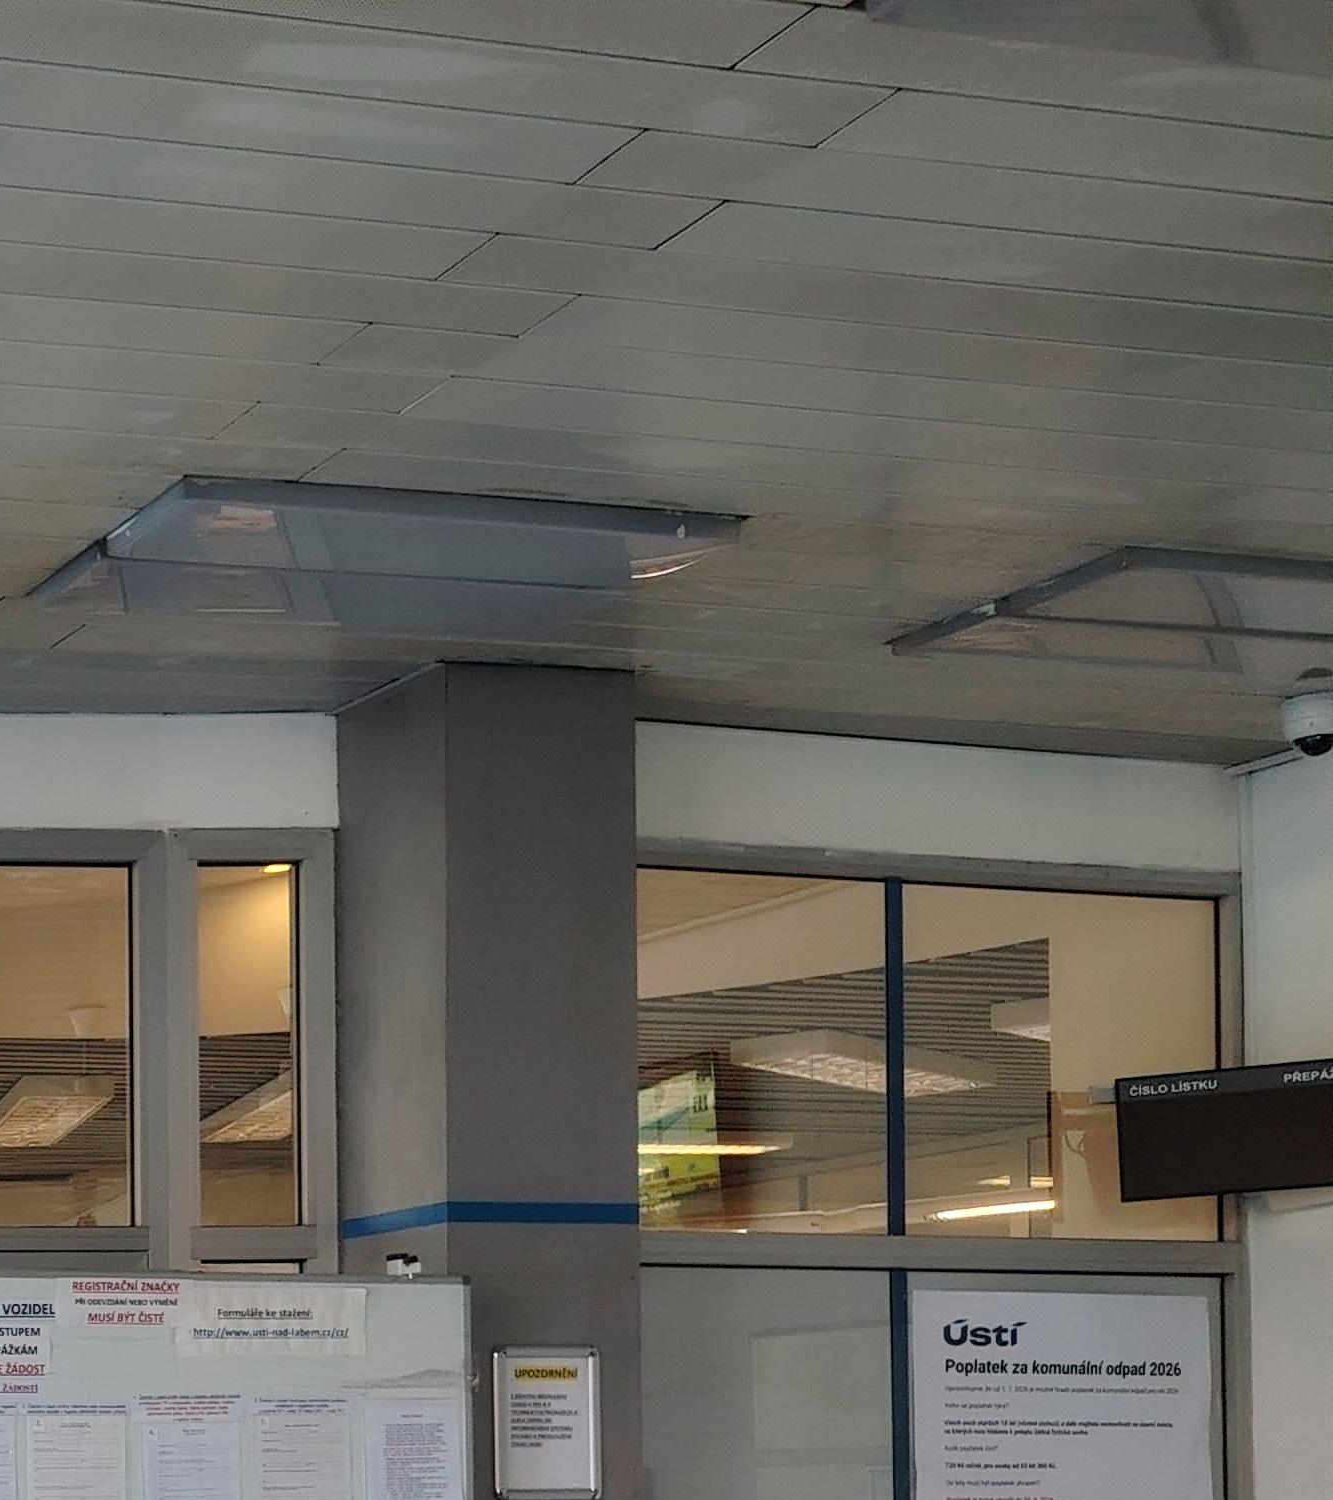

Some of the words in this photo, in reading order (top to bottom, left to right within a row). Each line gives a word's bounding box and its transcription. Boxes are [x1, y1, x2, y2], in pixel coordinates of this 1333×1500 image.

[1129, 1082, 1168, 1097] ČÍSLO
[1171, 1079, 1218, 1093] LÍSTKU
[72, 1280, 138, 1291] REGISTRAČNÍ
[141, 1280, 180, 1292] ZNAČKY
[2, 1303, 56, 1315] VOZIDEL
[217, 1307, 264, 1318] Formuláře
[265, 1308, 276, 1318] ke
[87, 1310, 115, 1323] MUSÍ
[117, 1311, 135, 1323] BÝT
[138, 1311, 165, 1323] ČISTÉ
[943, 1318, 1029, 1347] Ústí
[5, 1362, 45, 1374] ŽÁDOST
[514, 1367, 579, 1379] UPOZORNĚNÍ
[944, 1358, 1009, 1376] Poplatek
[1011, 1362, 1028, 1375] za
[1031, 1359, 1103, 1376] komunální
[1106, 1361, 1146, 1379] odpad
[1149, 1361, 1182, 1377] 2026
